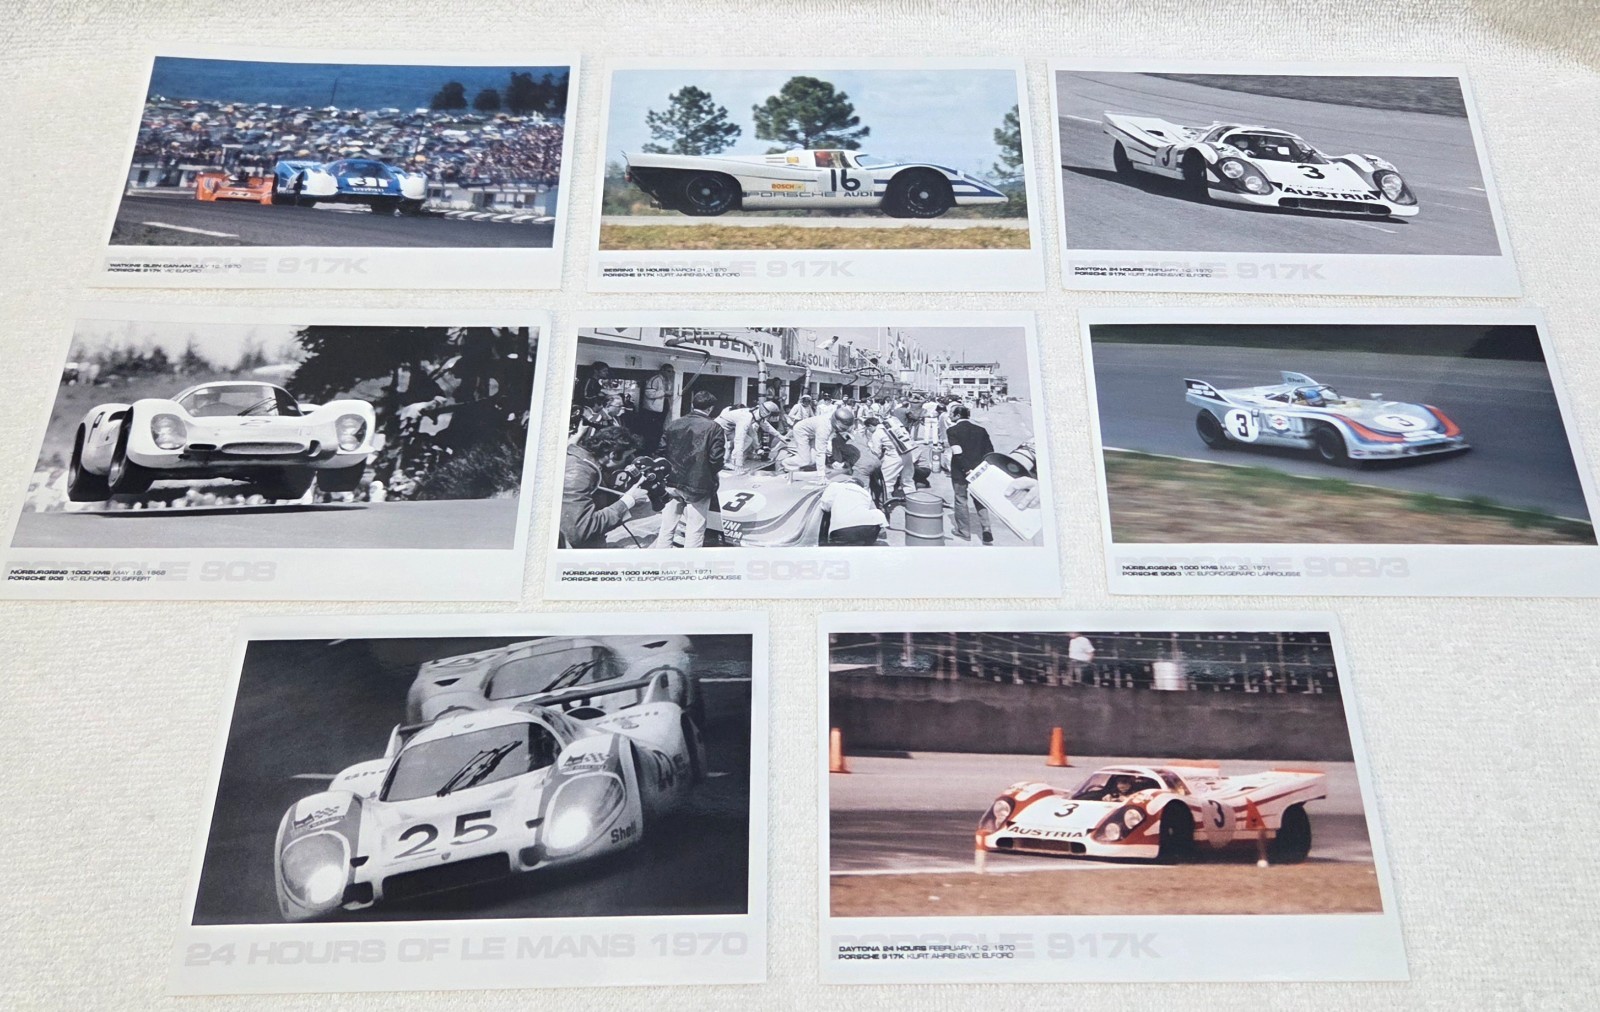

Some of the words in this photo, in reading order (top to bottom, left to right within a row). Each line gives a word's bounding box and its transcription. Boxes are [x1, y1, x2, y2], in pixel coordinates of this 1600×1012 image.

[830, 169, 861, 192] 16
[1297, 166, 1325, 180] 3
[1284, 187, 1378, 200] AUSTRIA
[277, 257, 368, 274] 917K
[766, 260, 855, 278] 917K
[1236, 262, 1326, 280] 917K
[1236, 413, 1249, 438] 3
[1386, 416, 1414, 426] 3
[722, 492, 754, 512] 3
[200, 560, 278, 582] 908
[747, 560, 850, 581] 908/3
[1304, 556, 1410, 578] 908/3
[1054, 804, 1080, 818] 3
[1208, 800, 1225, 828] 3
[397, 810, 498, 859] 25
[610, 820, 636, 844] Shell
[1008, 826, 1083, 838] AUSTRIA
[184, 943, 236, 967] 24
[247, 939, 386, 966] HOURS
[397, 937, 451, 962] OF
[461, 936, 507, 961] LE
[516, 934, 636, 959] MANS
[650, 931, 748, 958] 1970
[1047, 932, 1162, 959] 917K
